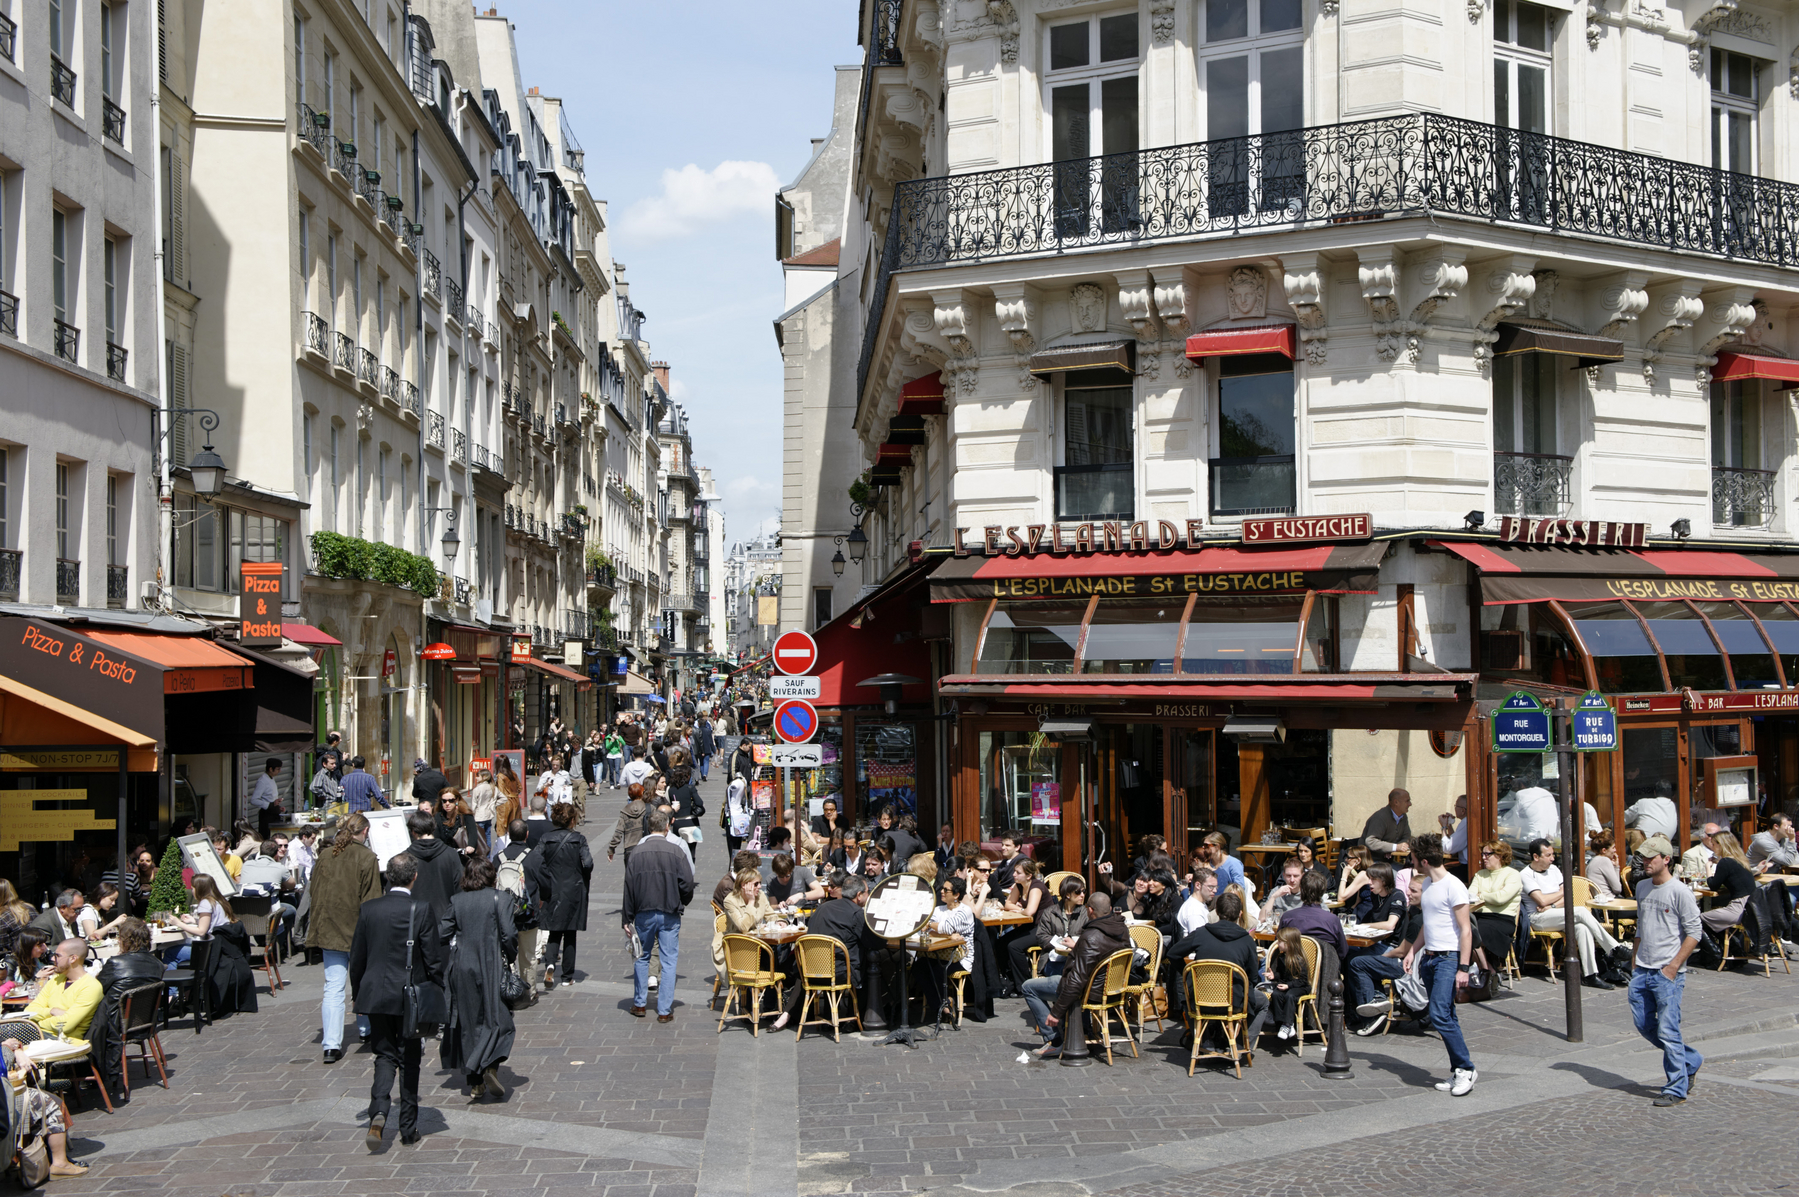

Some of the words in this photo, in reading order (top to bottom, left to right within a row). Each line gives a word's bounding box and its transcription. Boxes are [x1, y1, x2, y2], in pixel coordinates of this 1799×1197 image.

[1273, 517, 1365, 539] EUSTACHE
[1502, 517, 1651, 547] BRASSERIE
[953, 518, 1204, 556] L'ESPLANADE
[244, 576, 280, 593] Pizza
[993, 576, 1136, 597] L'ESPLANADE
[1150, 576, 1175, 593] St
[1184, 571, 1305, 591] EUSTACHE
[1606, 580, 1723, 598] L'ESPLANADE
[1730, 583, 1751, 598] St
[256, 598, 267, 615] &
[242, 620, 281, 637] Pasta
[21, 625, 64, 657] Pizza
[69, 642, 85, 664] &
[89, 650, 137, 684] Pasta
[785, 679, 806, 687] SAUF
[773, 688, 816, 696] RIVERAINS
[1626, 700, 1650, 709] Heineken
[1708, 697, 1724, 709] BAR
[1755, 694, 1799, 707] L'ESPLANA
[1065, 703, 1086, 715] BAR
[1514, 719, 1529, 728] RUE
[1585, 717, 1603, 727] RUE
[1499, 733, 1545, 742] MONTORGUEIL
[1577, 733, 1613, 745] TURBIGO
[30, 754, 92, 764] NON-STOP
[95, 754, 119, 764] 7J/7
[19, 832, 70, 840] RIBS-FISHES
